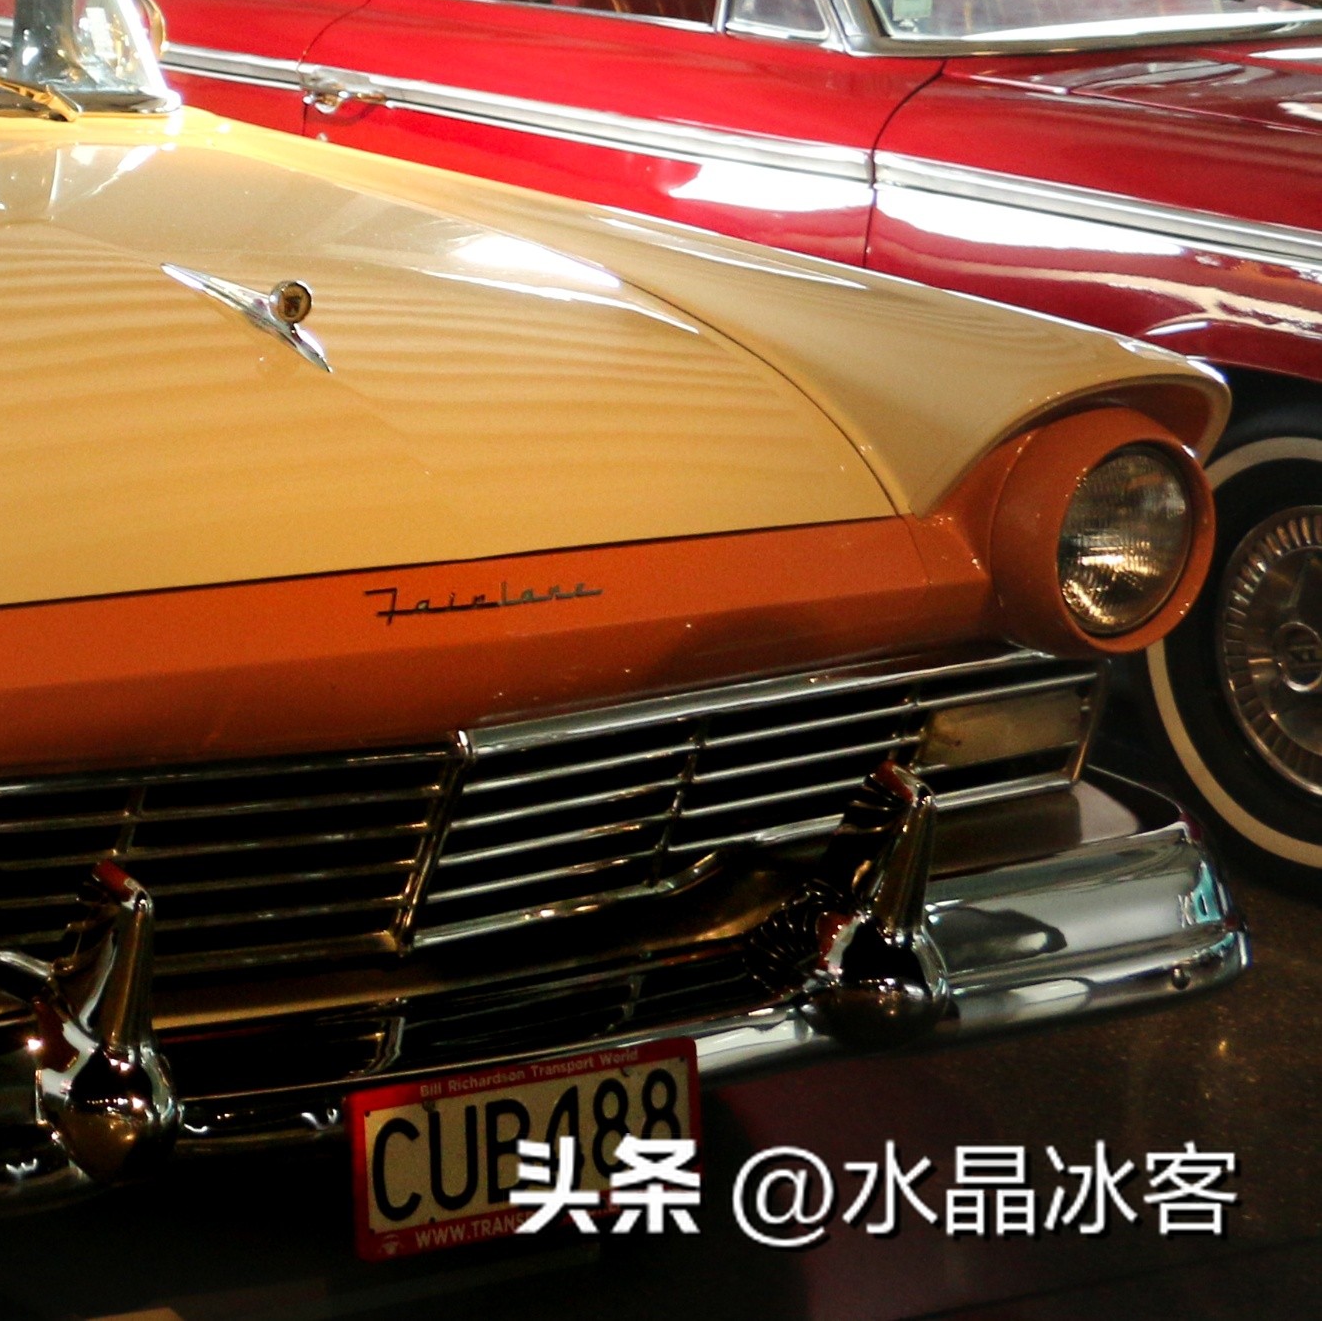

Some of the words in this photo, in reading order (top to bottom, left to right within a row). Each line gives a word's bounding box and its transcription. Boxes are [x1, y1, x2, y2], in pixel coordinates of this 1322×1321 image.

[363, 580, 603, 626] Fairlane
[420, 1081, 442, 1098] Bill
[447, 1069, 525, 1092] Richardson
[530, 1058, 596, 1078] Transport
[600, 1048, 639, 1067] World
